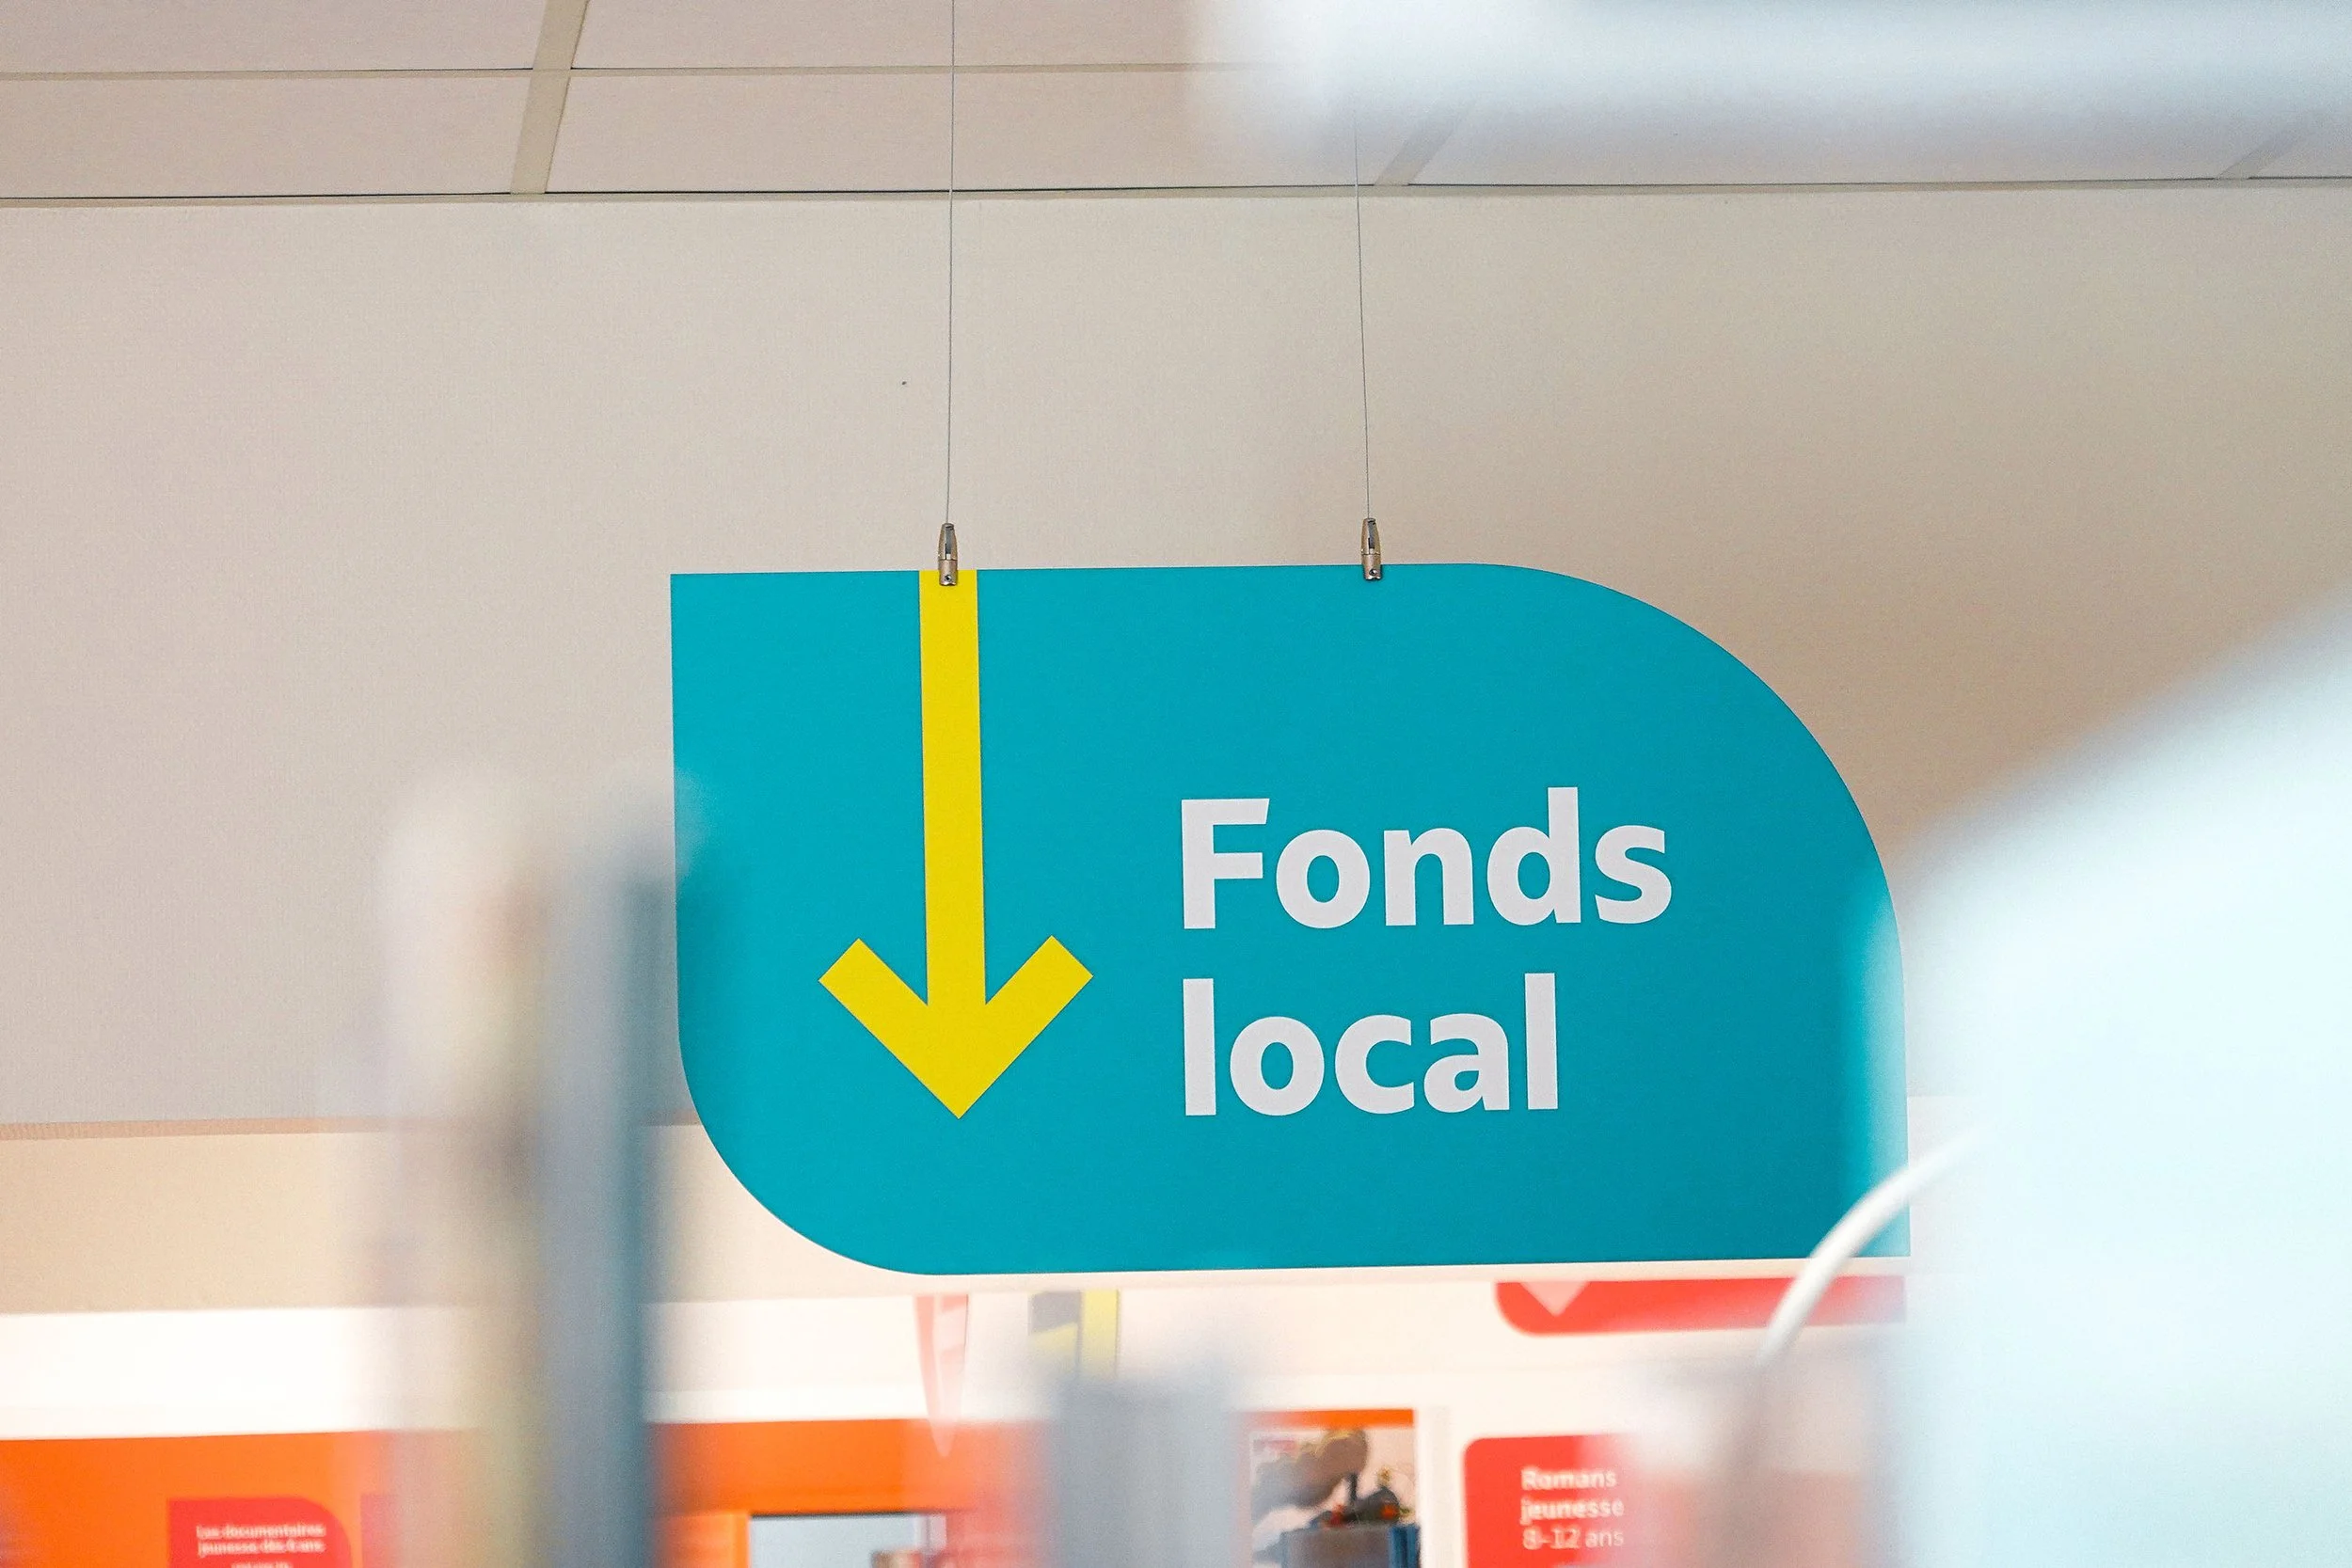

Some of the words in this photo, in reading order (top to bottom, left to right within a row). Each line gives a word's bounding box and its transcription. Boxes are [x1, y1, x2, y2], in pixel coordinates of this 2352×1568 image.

[1182, 787, 1672, 929] Fonds
[1183, 973, 1558, 1116] local
[1521, 1467, 1617, 1489] Romans
[1520, 1497, 1625, 1525] jeunesse
[1522, 1528, 1581, 1549] 8-12
[1585, 1530, 1624, 1547] ans
